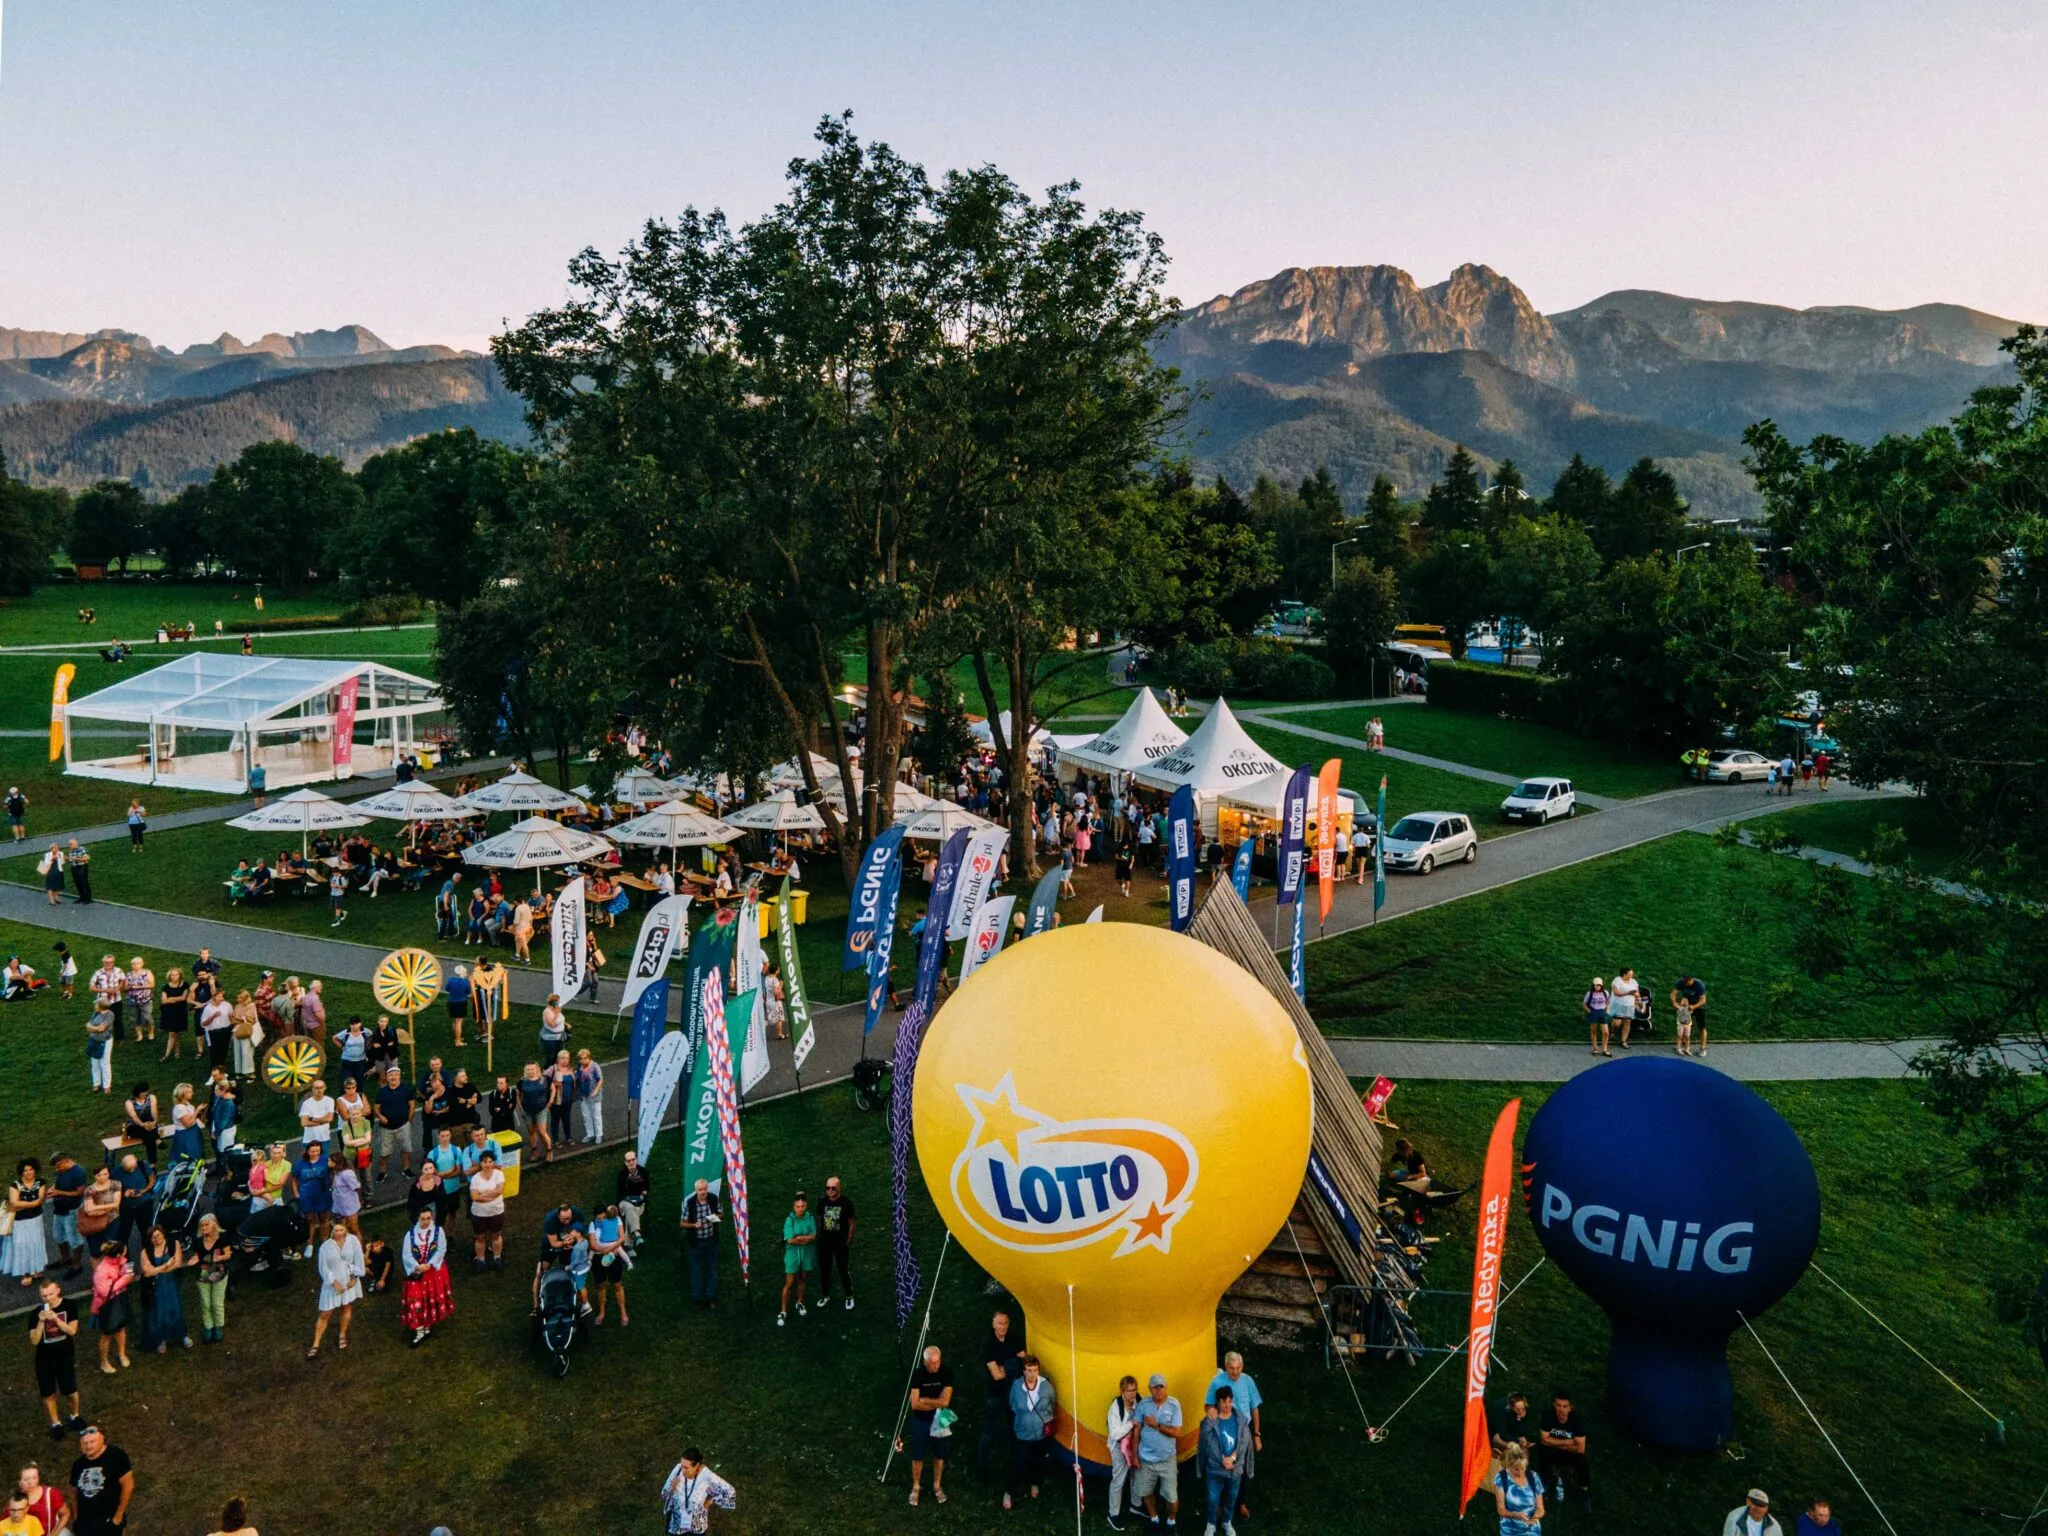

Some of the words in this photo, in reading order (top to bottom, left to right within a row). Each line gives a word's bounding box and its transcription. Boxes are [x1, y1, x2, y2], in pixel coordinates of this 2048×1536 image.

[1144, 745, 1178, 758] OKOC
[1222, 762, 1278, 778] OKOCIM
[312, 815, 343, 824] OKOCIM
[912, 825, 942, 833] OKOCIM
[1293, 807, 1302, 832] TVP
[677, 831, 709, 839] OKOCIM
[486, 850, 517, 858] OKOCIM
[527, 850, 562, 859] OKOCIM
[1288, 857, 1300, 885] TVP
[1179, 886, 1187, 911] TVP
[779, 901, 808, 1024] ZAKOPANE
[690, 1068, 718, 1165] ZAKOPA
[988, 1154, 1139, 1224] LOTTO
[1541, 1183, 1754, 1274] PGNiG
[1474, 1194, 1500, 1314] Jedynka
